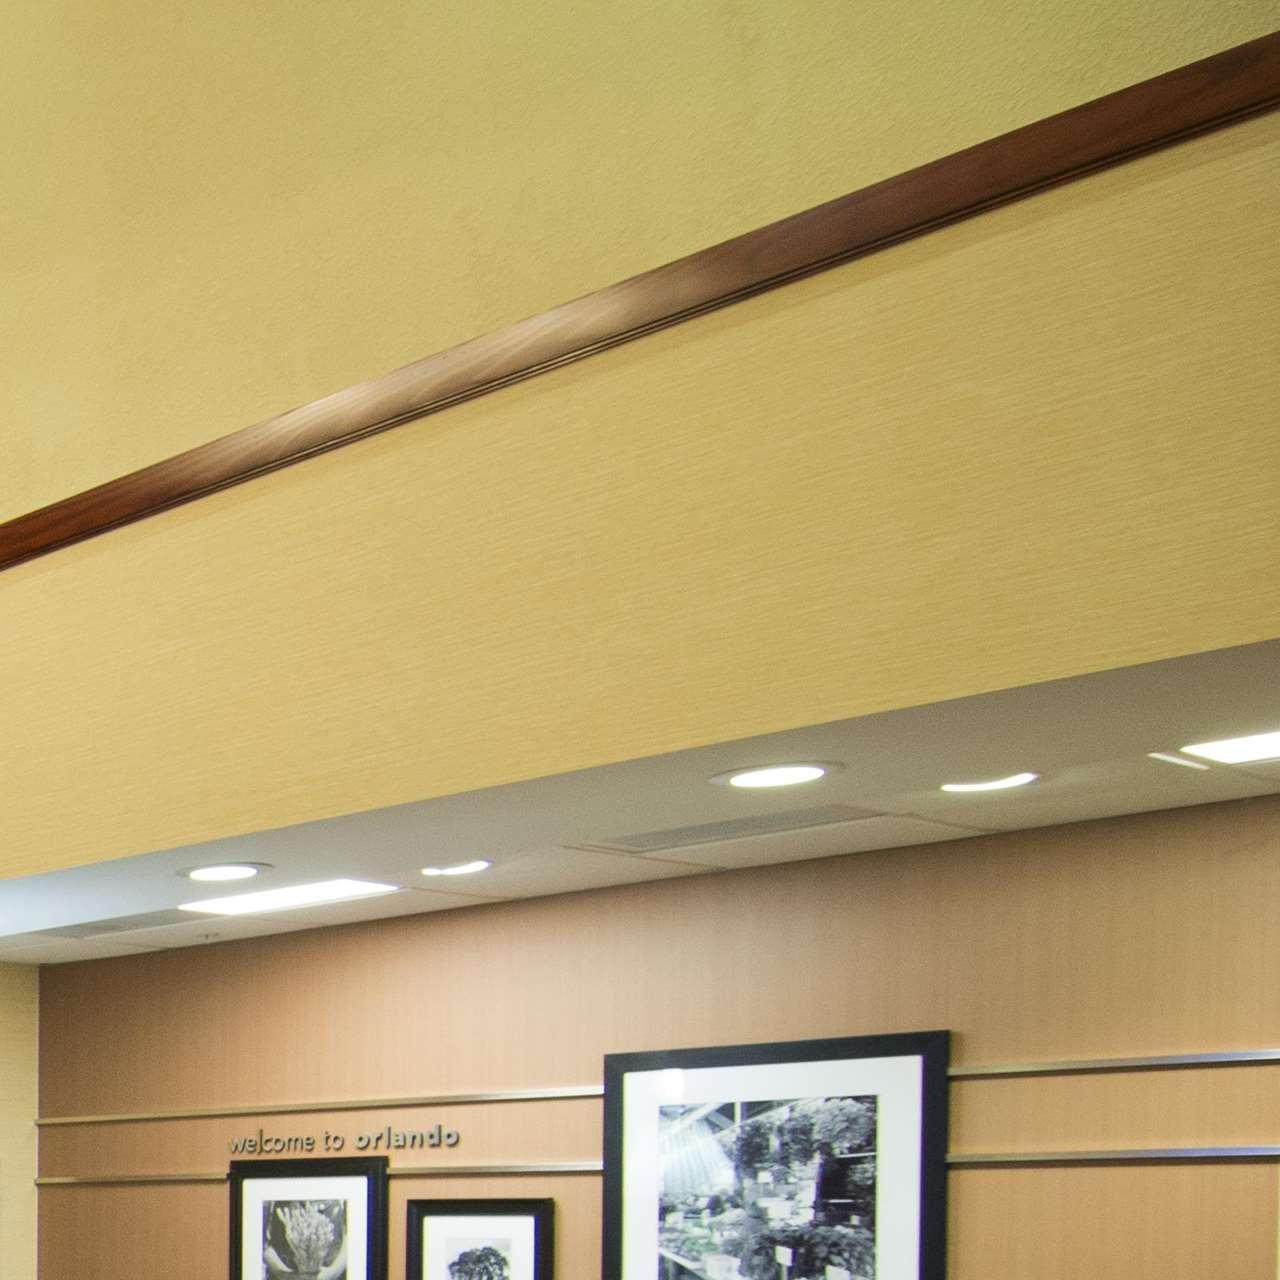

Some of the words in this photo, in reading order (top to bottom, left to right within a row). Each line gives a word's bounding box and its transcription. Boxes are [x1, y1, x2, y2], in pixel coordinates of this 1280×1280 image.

[229, 1128, 316, 1155] welcome
[323, 1130, 345, 1150] to
[355, 1124, 460, 1150] orlando
